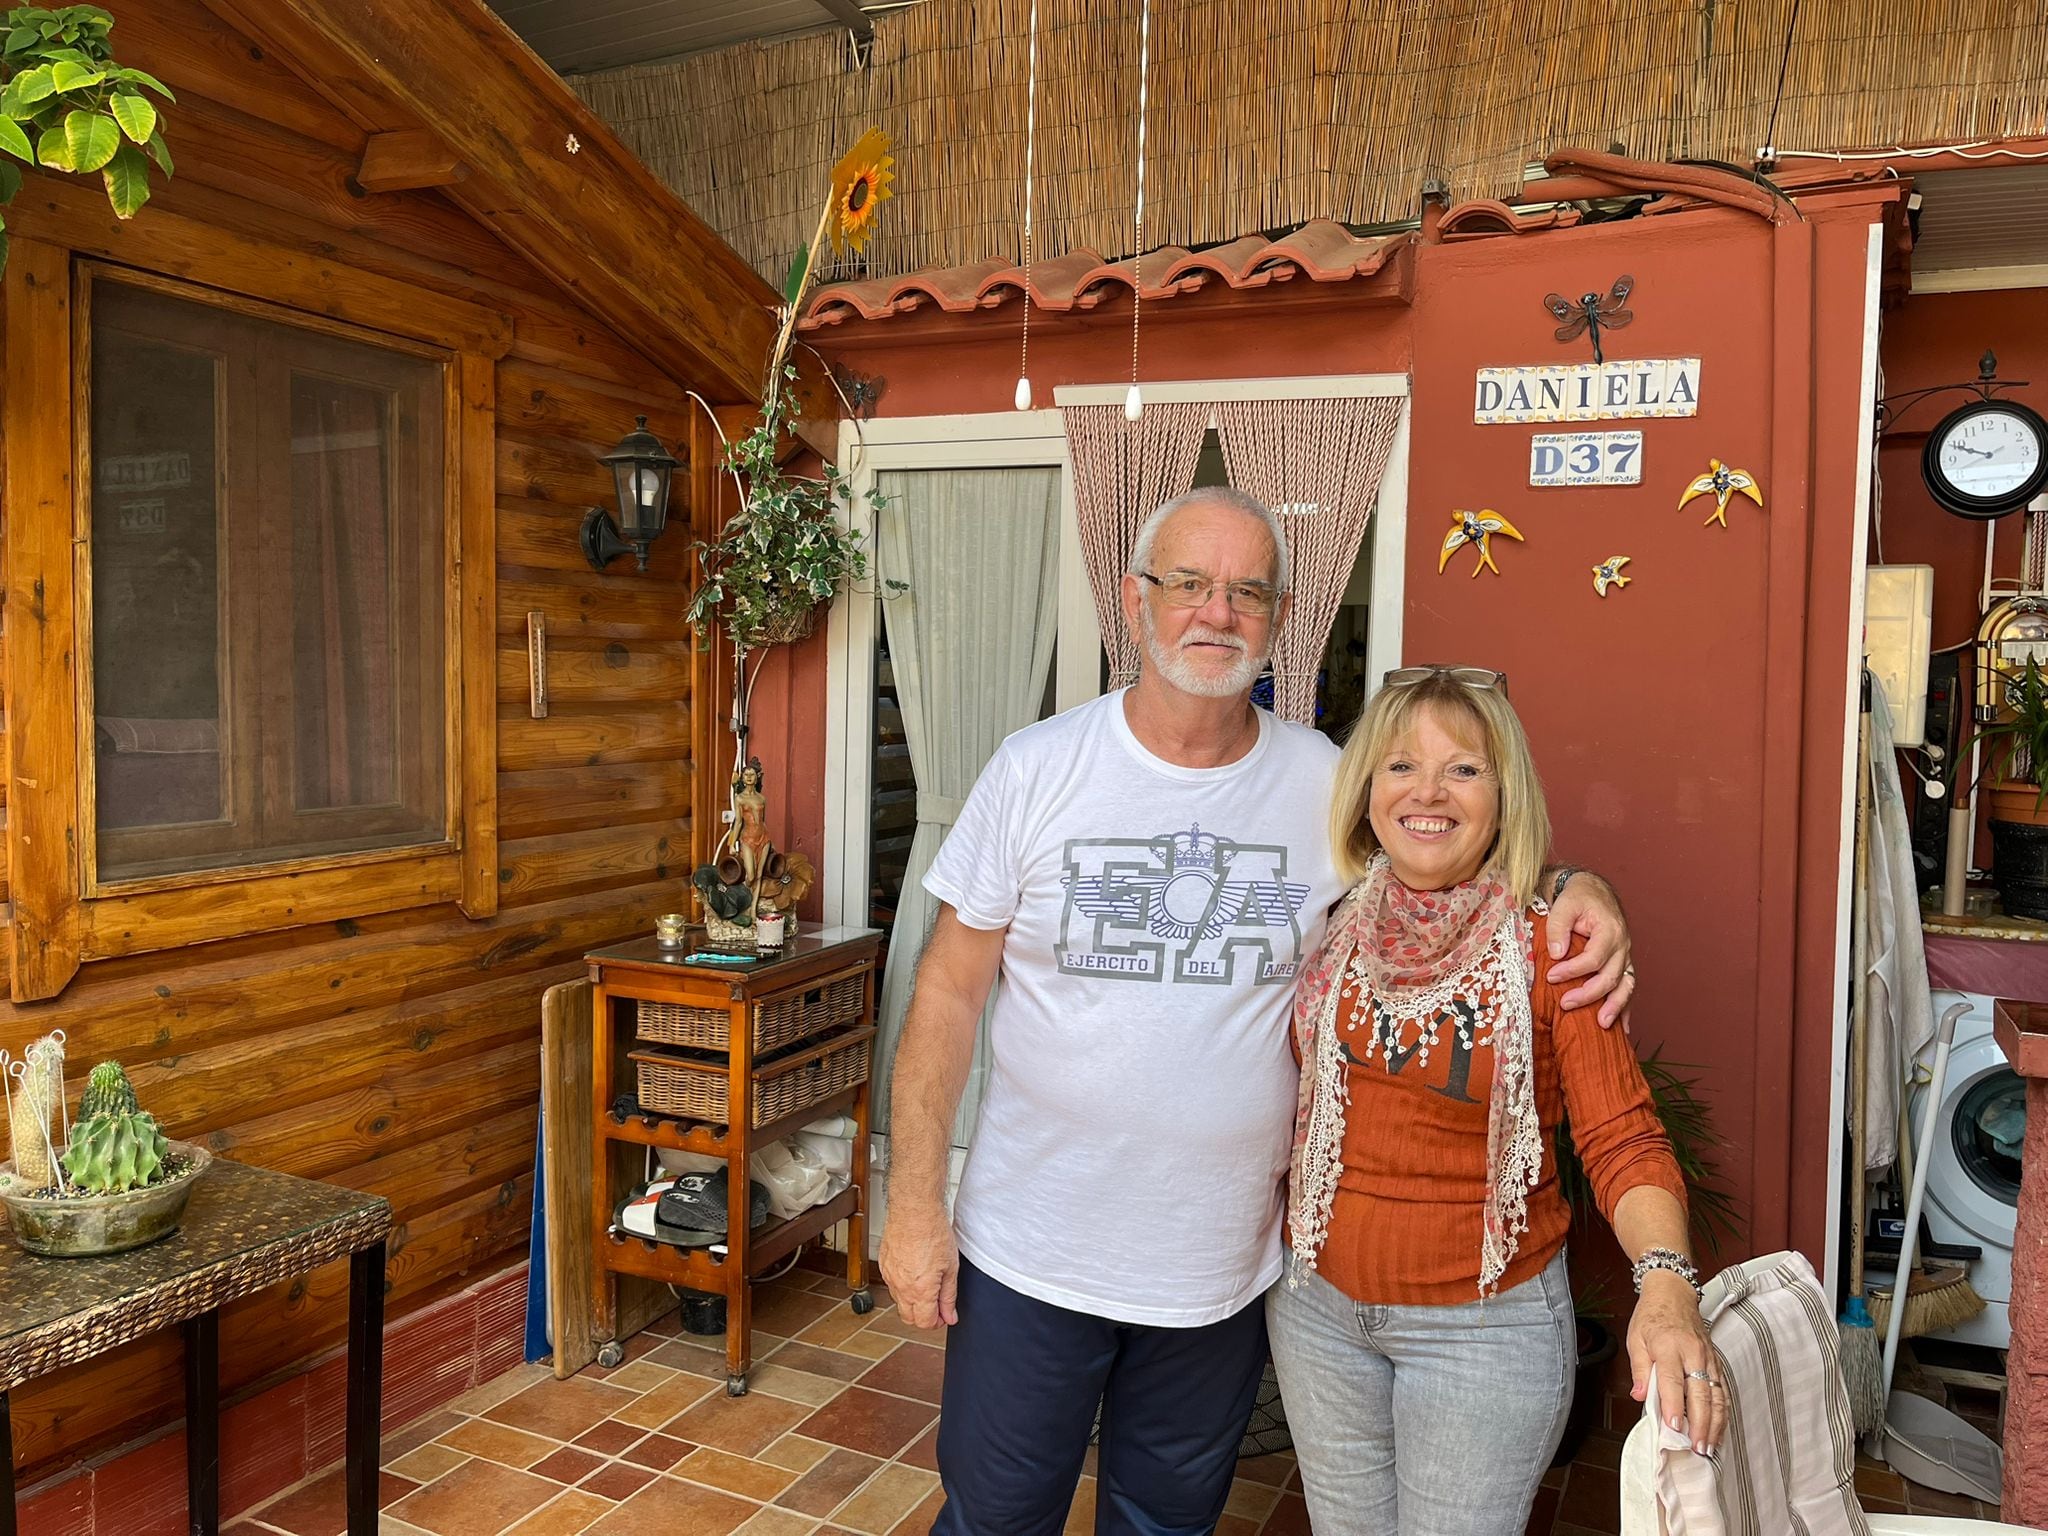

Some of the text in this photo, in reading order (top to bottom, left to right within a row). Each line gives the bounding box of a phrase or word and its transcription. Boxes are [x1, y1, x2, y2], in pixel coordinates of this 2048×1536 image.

[1476, 371, 1696, 411] DANIELA
[1981, 420, 1994, 431] 12
[1964, 426, 1976, 438] 11
[2015, 432, 2023, 442] 2
[2021, 446, 2029, 457] 3
[1532, 443, 1640, 475] D37
[1949, 455, 1957, 466] 9
[1066, 954, 1294, 977] EJERCITO DEL AIRE
